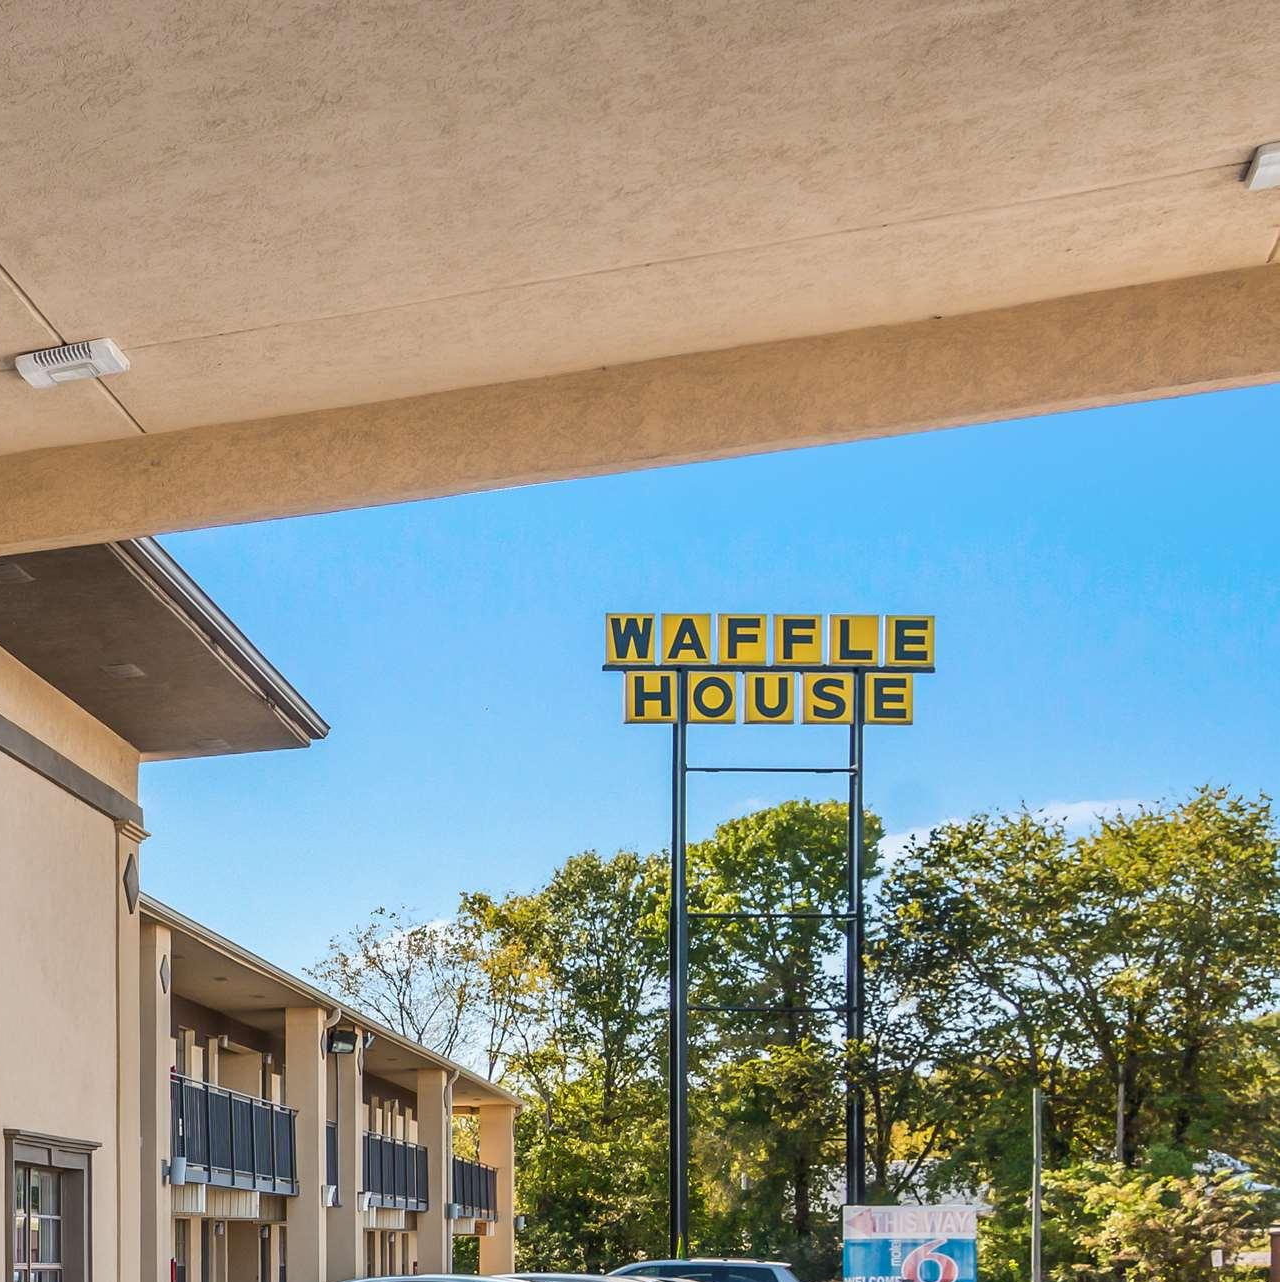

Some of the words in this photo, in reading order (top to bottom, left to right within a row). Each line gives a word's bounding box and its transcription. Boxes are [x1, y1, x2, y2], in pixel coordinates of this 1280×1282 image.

[609, 617, 929, 660] WAFFLE
[634, 675, 908, 719] HOUSE
[874, 1211, 919, 1233] THIS
[923, 1211, 970, 1233] WAY
